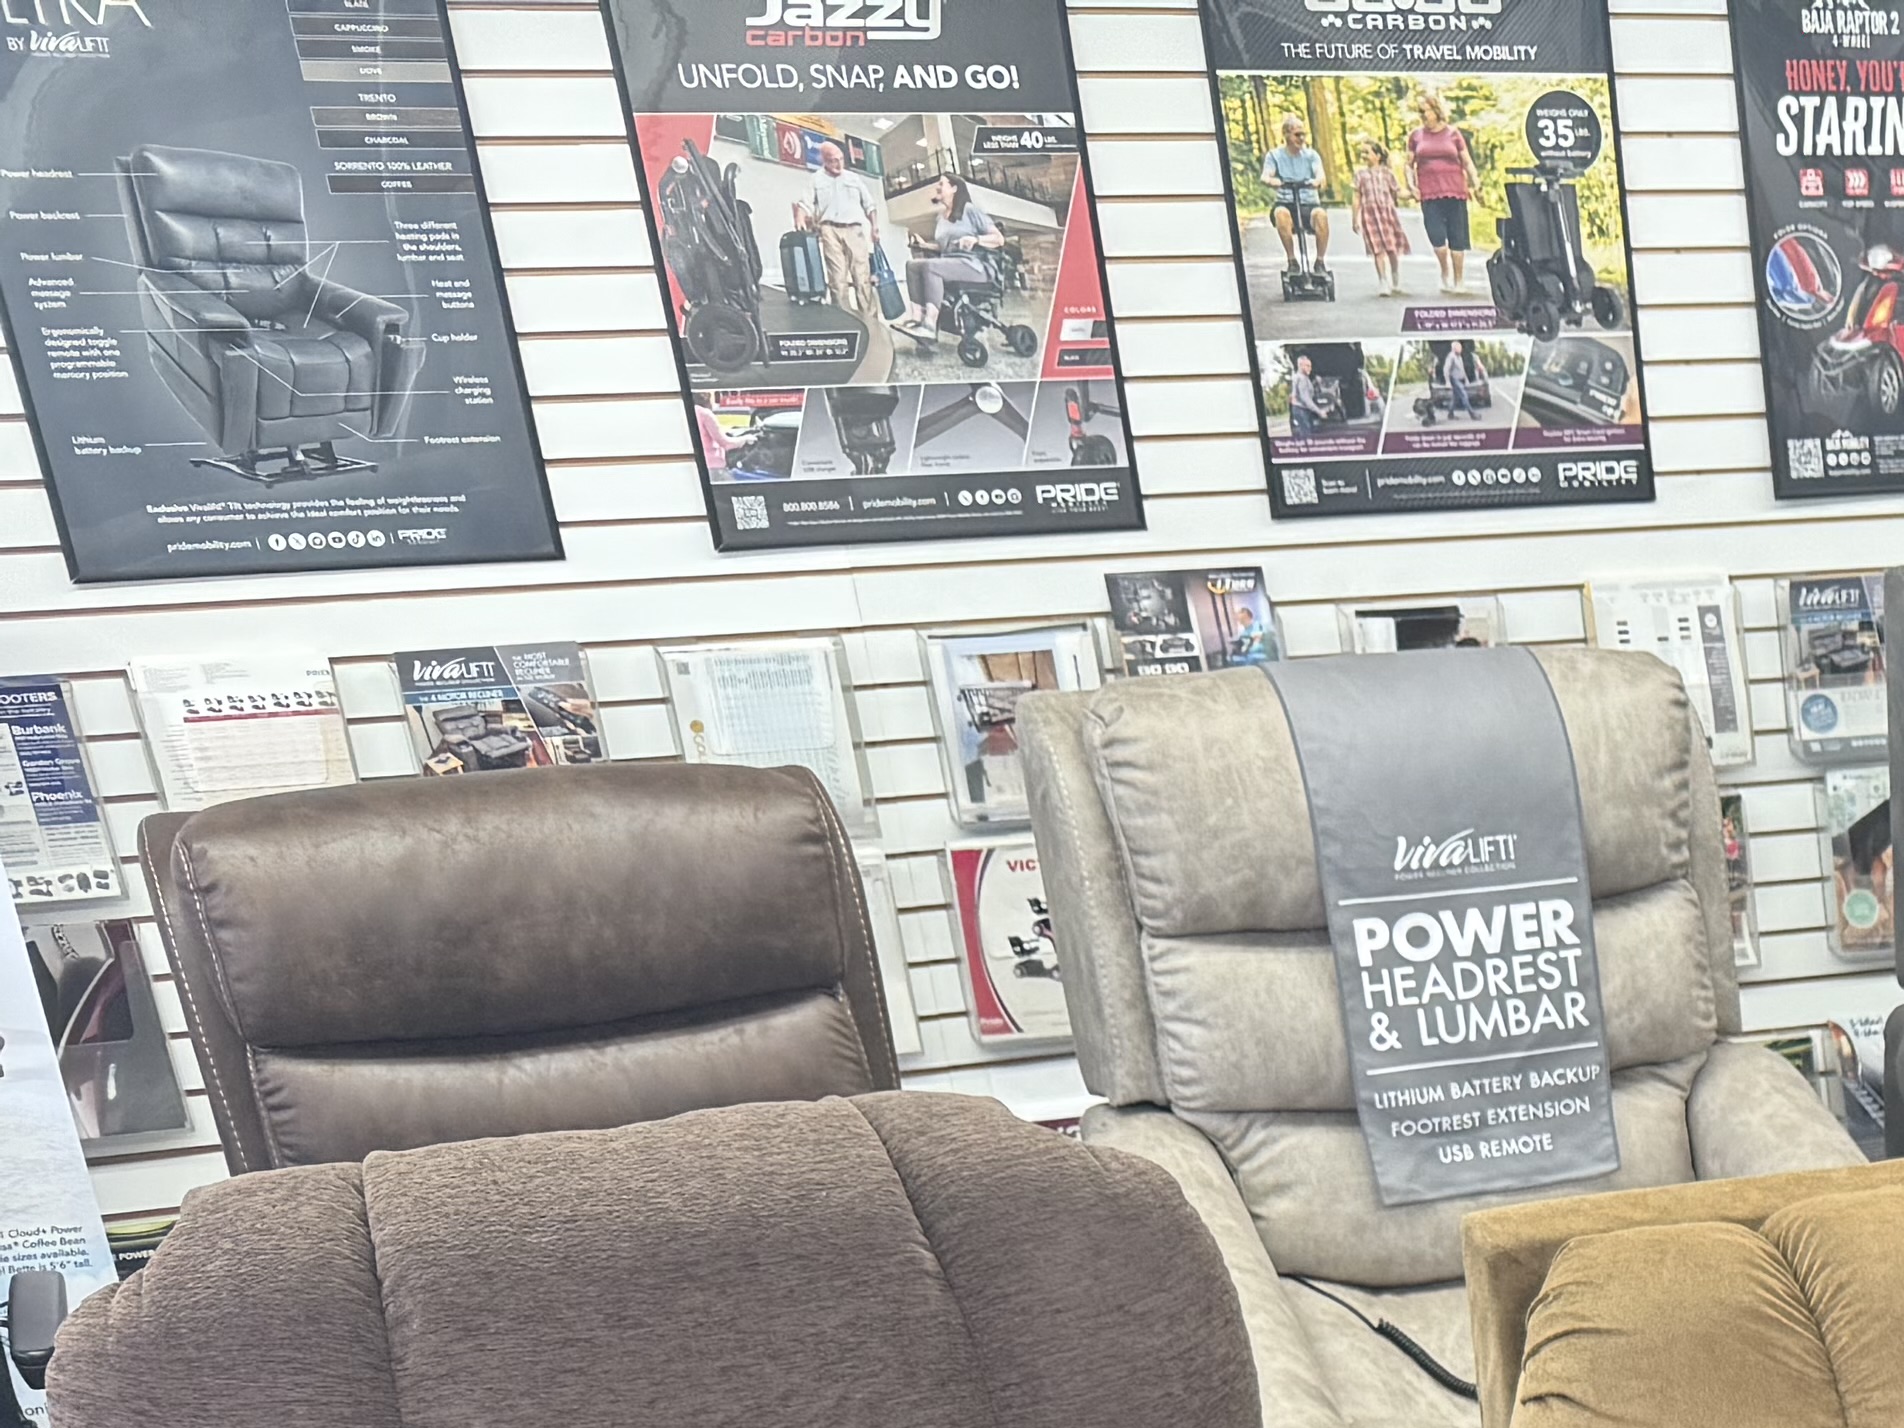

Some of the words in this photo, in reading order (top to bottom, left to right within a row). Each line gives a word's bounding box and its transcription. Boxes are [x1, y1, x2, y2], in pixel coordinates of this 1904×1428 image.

[334, 24, 389, 33] CAPPUCCINO
[1347, 13, 1468, 32] CARBON
[1801, 9, 1835, 34] BAJA
[1836, 11, 1889, 35] RAPTOR
[1890, 11, 1901, 35] 2
[6, 36, 24, 51] BY
[745, 24, 866, 47] carbon
[1281, 42, 1313, 60] THE
[1315, 43, 1373, 60] FUTURE
[1377, 44, 1400, 60] OF
[1402, 45, 1462, 61] TRAVEL
[1466, 45, 1539, 62] MOBILITY
[677, 62, 805, 93] UNFOLD,
[811, 63, 885, 93] SNAP,
[893, 65, 959, 90] AND
[964, 65, 1021, 90] GO!
[1785, 59, 1852, 94] HONEY,
[358, 93, 396, 103] TRENTO
[1020, 130, 1044, 149] 40
[1537, 118, 1576, 148] 35
[334, 161, 385, 171] SORRENTO
[413, 162, 453, 171] LEATHER
[1557, 459, 1640, 482] PRIDE
[1036, 482, 1120, 504] PRIDE
[11, 723, 67, 736] Burbank
[31, 789, 84, 802] Phoenix
[1353, 898, 1581, 968] POWER
[1360, 947, 1583, 1010] HEADREST
[1368, 1010, 1403, 1052] &
[1416, 990, 1590, 1048] LUMBAR
[1374, 1083, 1446, 1111] LITHIUM
[1449, 1073, 1523, 1101] BATTERY
[1529, 1064, 1601, 1090] BACKUP
[1391, 1110, 1481, 1138] FOOTREST
[1487, 1096, 1591, 1126] EXTENSION
[1438, 1142, 1475, 1165] USB
[1479, 1133, 1554, 1160] REMOTE
[8, 1227, 47, 1239] Cloud+
[51, 1225, 83, 1235] Power
[22, 1239, 57, 1250] Coffee
[60, 1237, 86, 1246] Bean
[13, 1252, 38, 1262] sizes
[40, 1249, 90, 1261] available.
